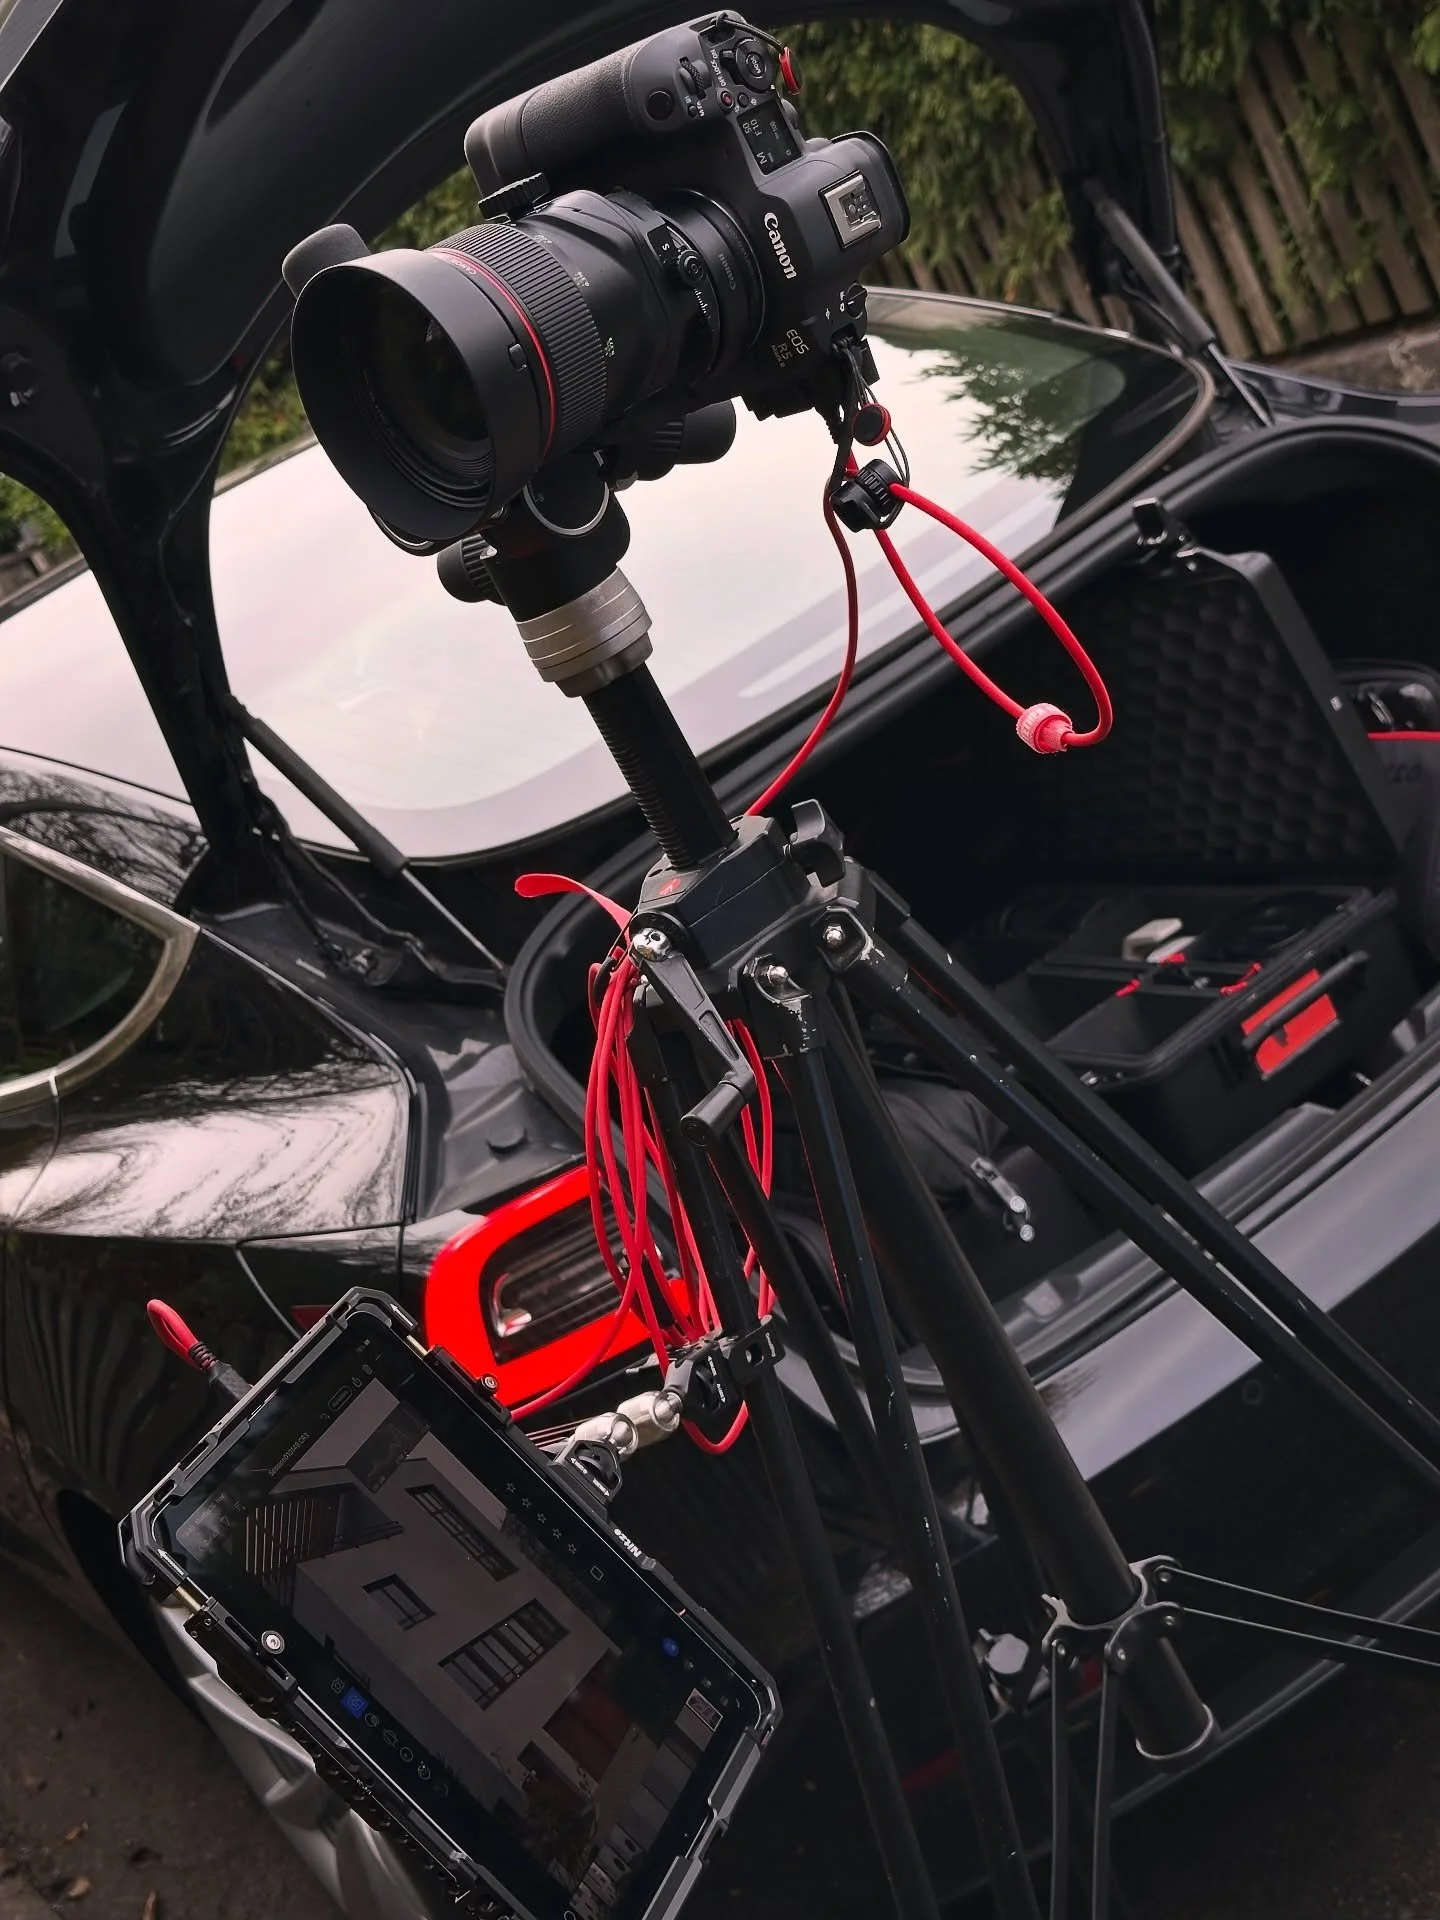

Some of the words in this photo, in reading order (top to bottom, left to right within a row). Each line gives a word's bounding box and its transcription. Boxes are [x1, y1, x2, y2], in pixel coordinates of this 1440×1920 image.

[756, 151, 768, 165] M
[764, 212, 797, 280] Canon
[717, 253, 737, 291] Canon
[777, 343, 793, 361] R5
[786, 329, 809, 355] EOS
[613, 1527, 642, 1558] Nitze
